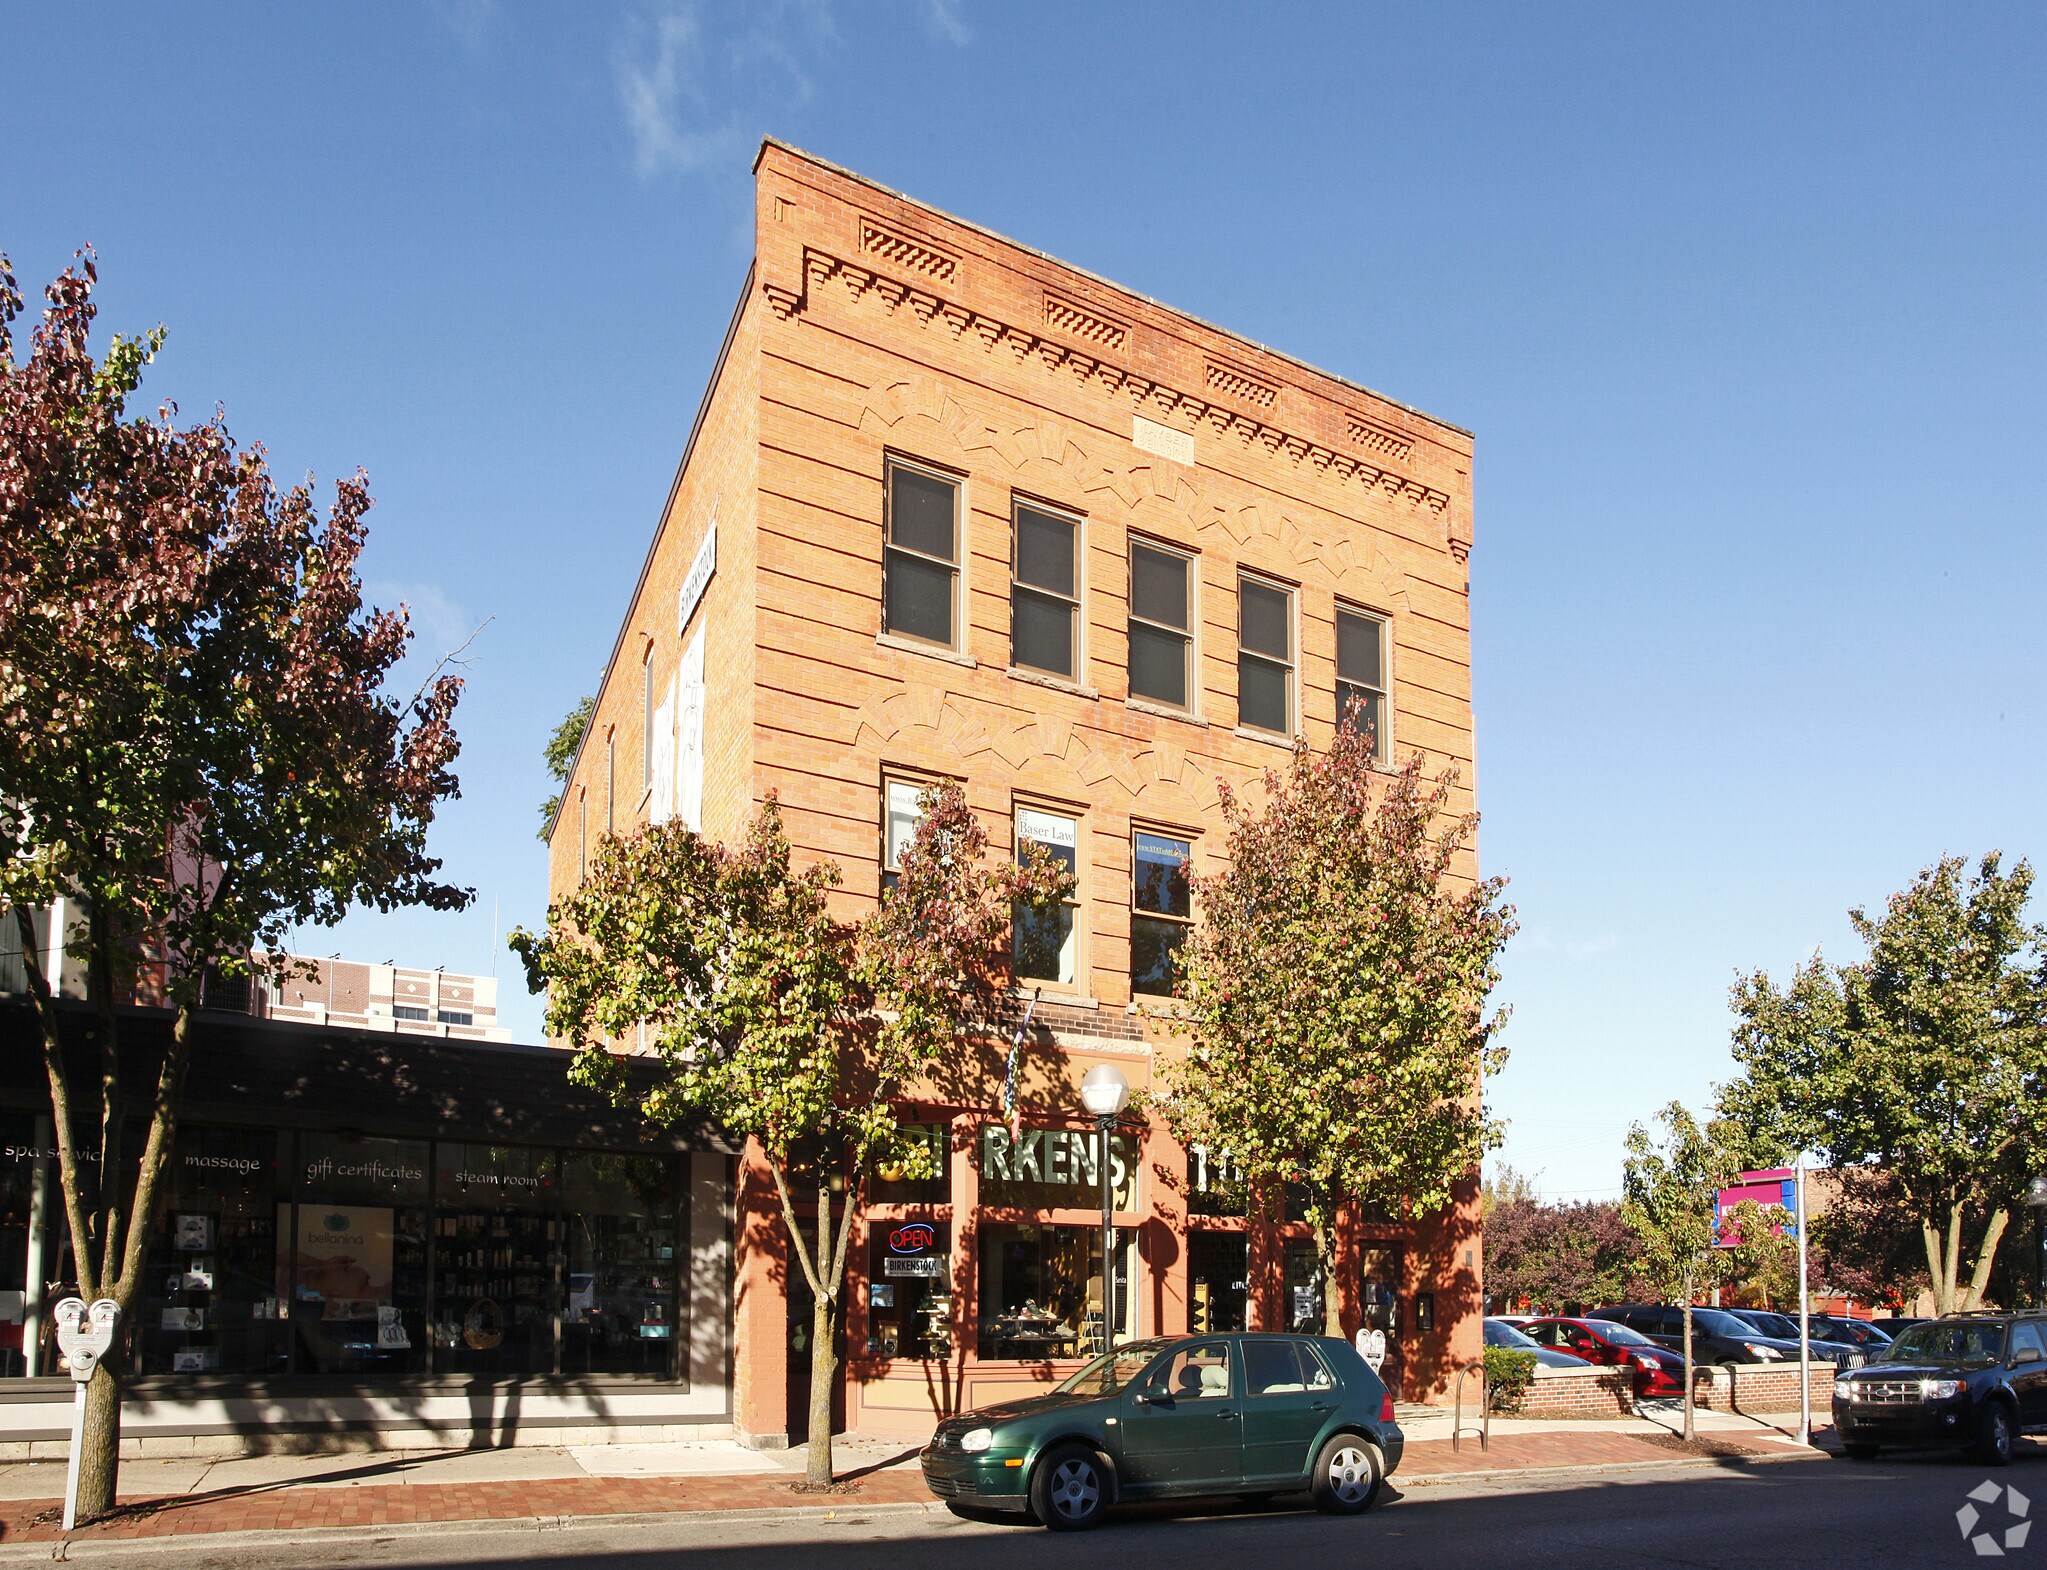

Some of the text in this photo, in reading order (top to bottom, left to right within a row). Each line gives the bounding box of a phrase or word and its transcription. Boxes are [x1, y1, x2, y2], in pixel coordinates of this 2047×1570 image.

[1020, 821, 1073, 841] Baser Law
[5, 1145, 40, 1162] spa
[185, 1156, 260, 1175] massage
[307, 1157, 422, 1183] gift certificates
[456, 1170, 538, 1187] steam room
[889, 1230, 933, 1247] OPEN
[889, 1260, 937, 1271] BIRKENSTOCK
